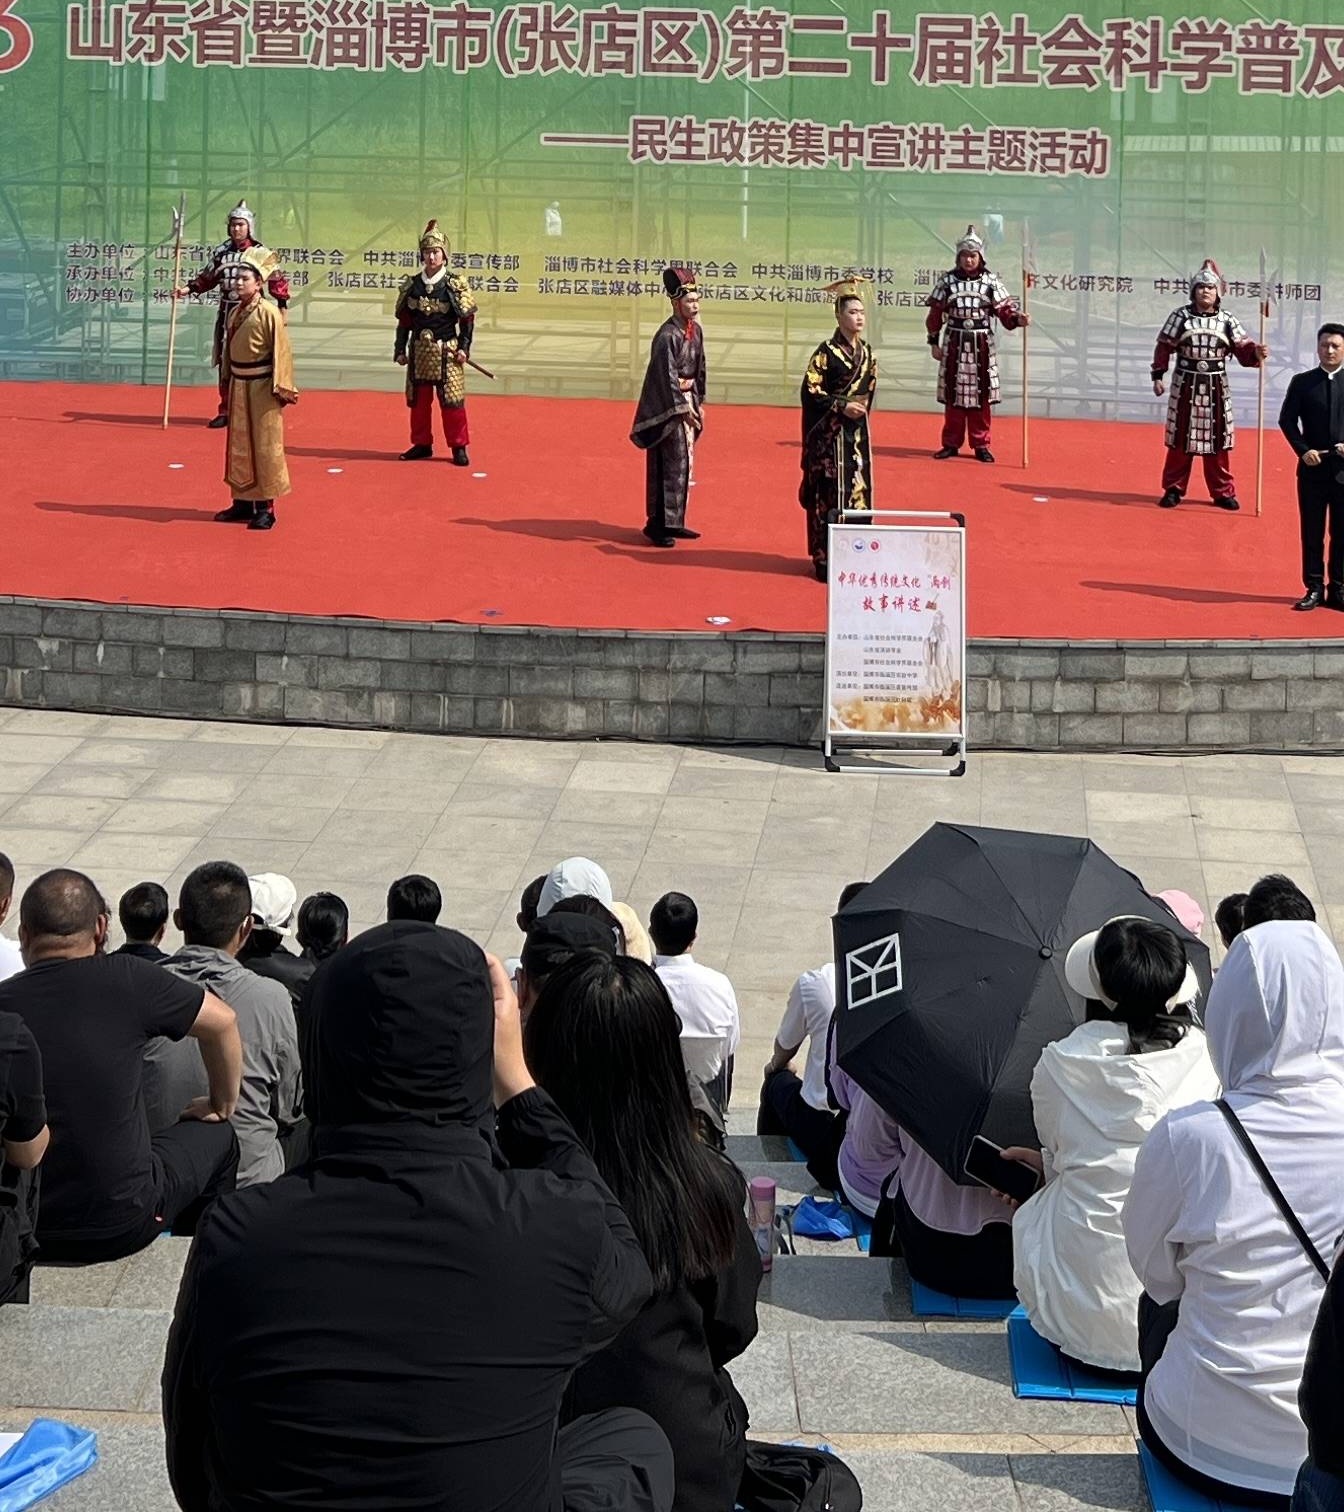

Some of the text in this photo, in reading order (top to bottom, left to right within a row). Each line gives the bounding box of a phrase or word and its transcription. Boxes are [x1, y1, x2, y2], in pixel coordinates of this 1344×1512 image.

[363, 249, 520, 271] 中共淄委宣传部
[538, 277, 673, 299] 张店区融媒体中
